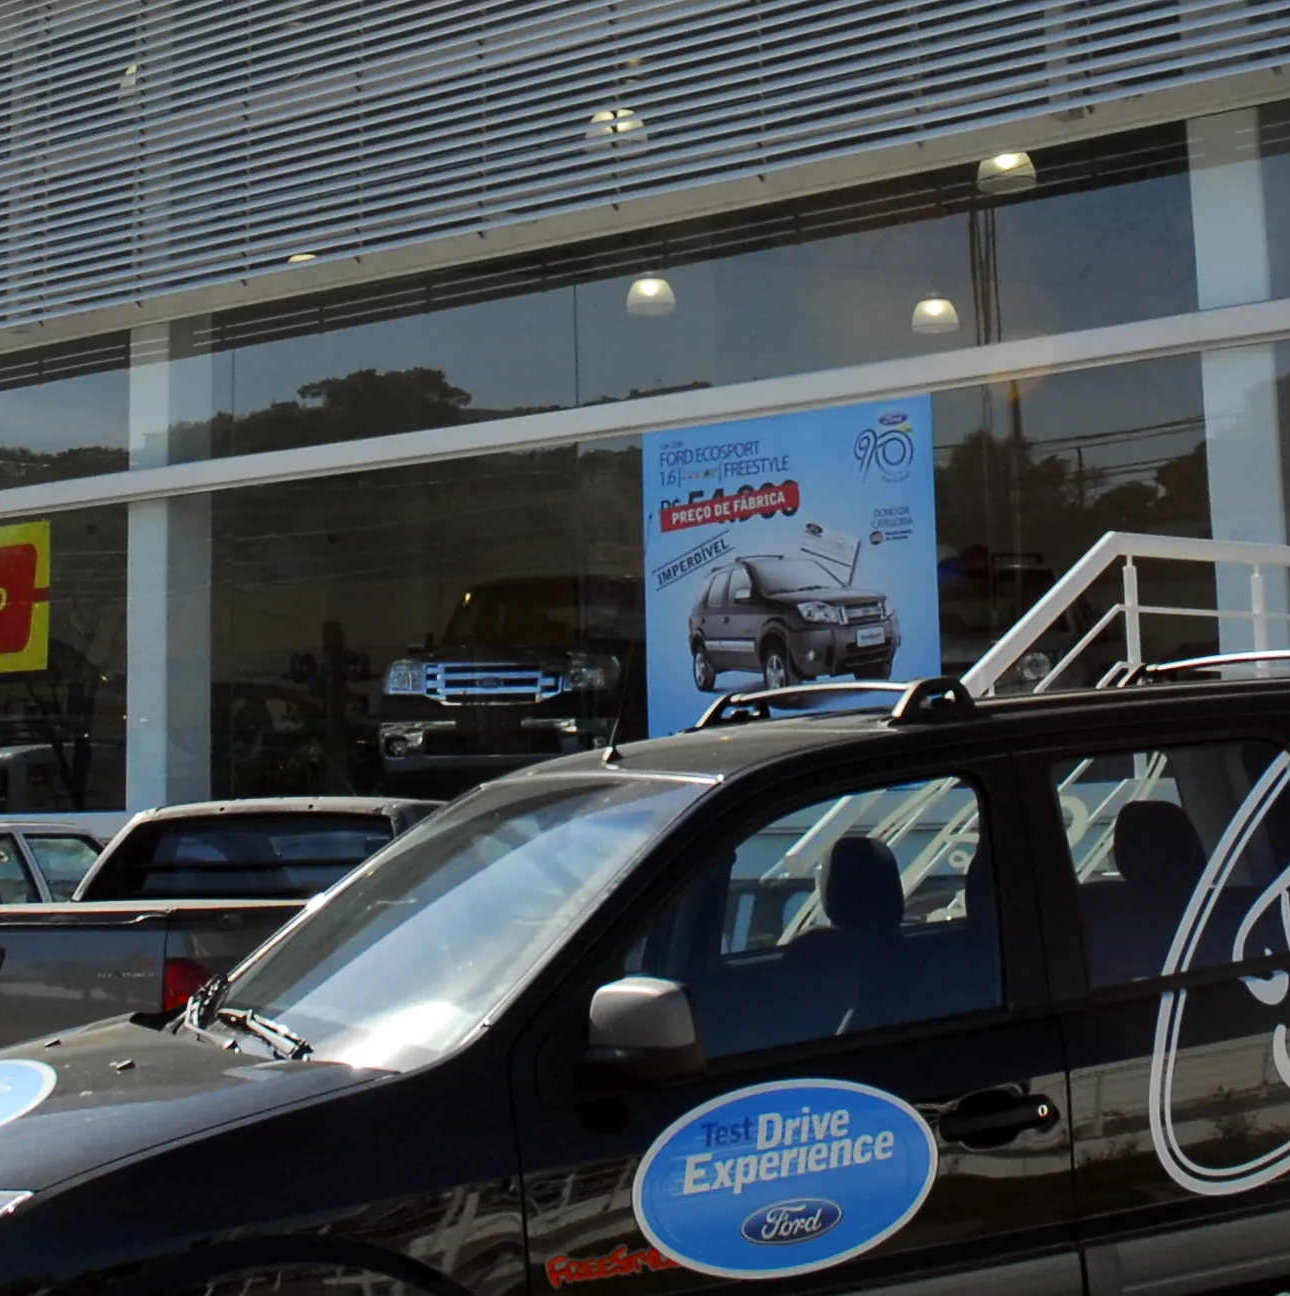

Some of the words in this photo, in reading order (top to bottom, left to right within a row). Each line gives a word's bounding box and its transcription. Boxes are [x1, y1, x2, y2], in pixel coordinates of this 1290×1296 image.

[660, 447, 694, 467] FORD
[696, 440, 760, 463] ECOSPORT
[660, 471, 676, 487] 1.6
[724, 455, 790, 478] FREESTYLE
[672, 507, 710, 525] PREÇO
[714, 503, 731, 516] DE
[734, 491, 786, 512] FÁBRICA
[657, 538, 730, 585] IMPERDÍVEL
[701, 1116, 753, 1148] Test
[756, 1106, 849, 1150] Drive
[682, 1130, 895, 1195] Experience
[760, 1203, 822, 1240] Ford
